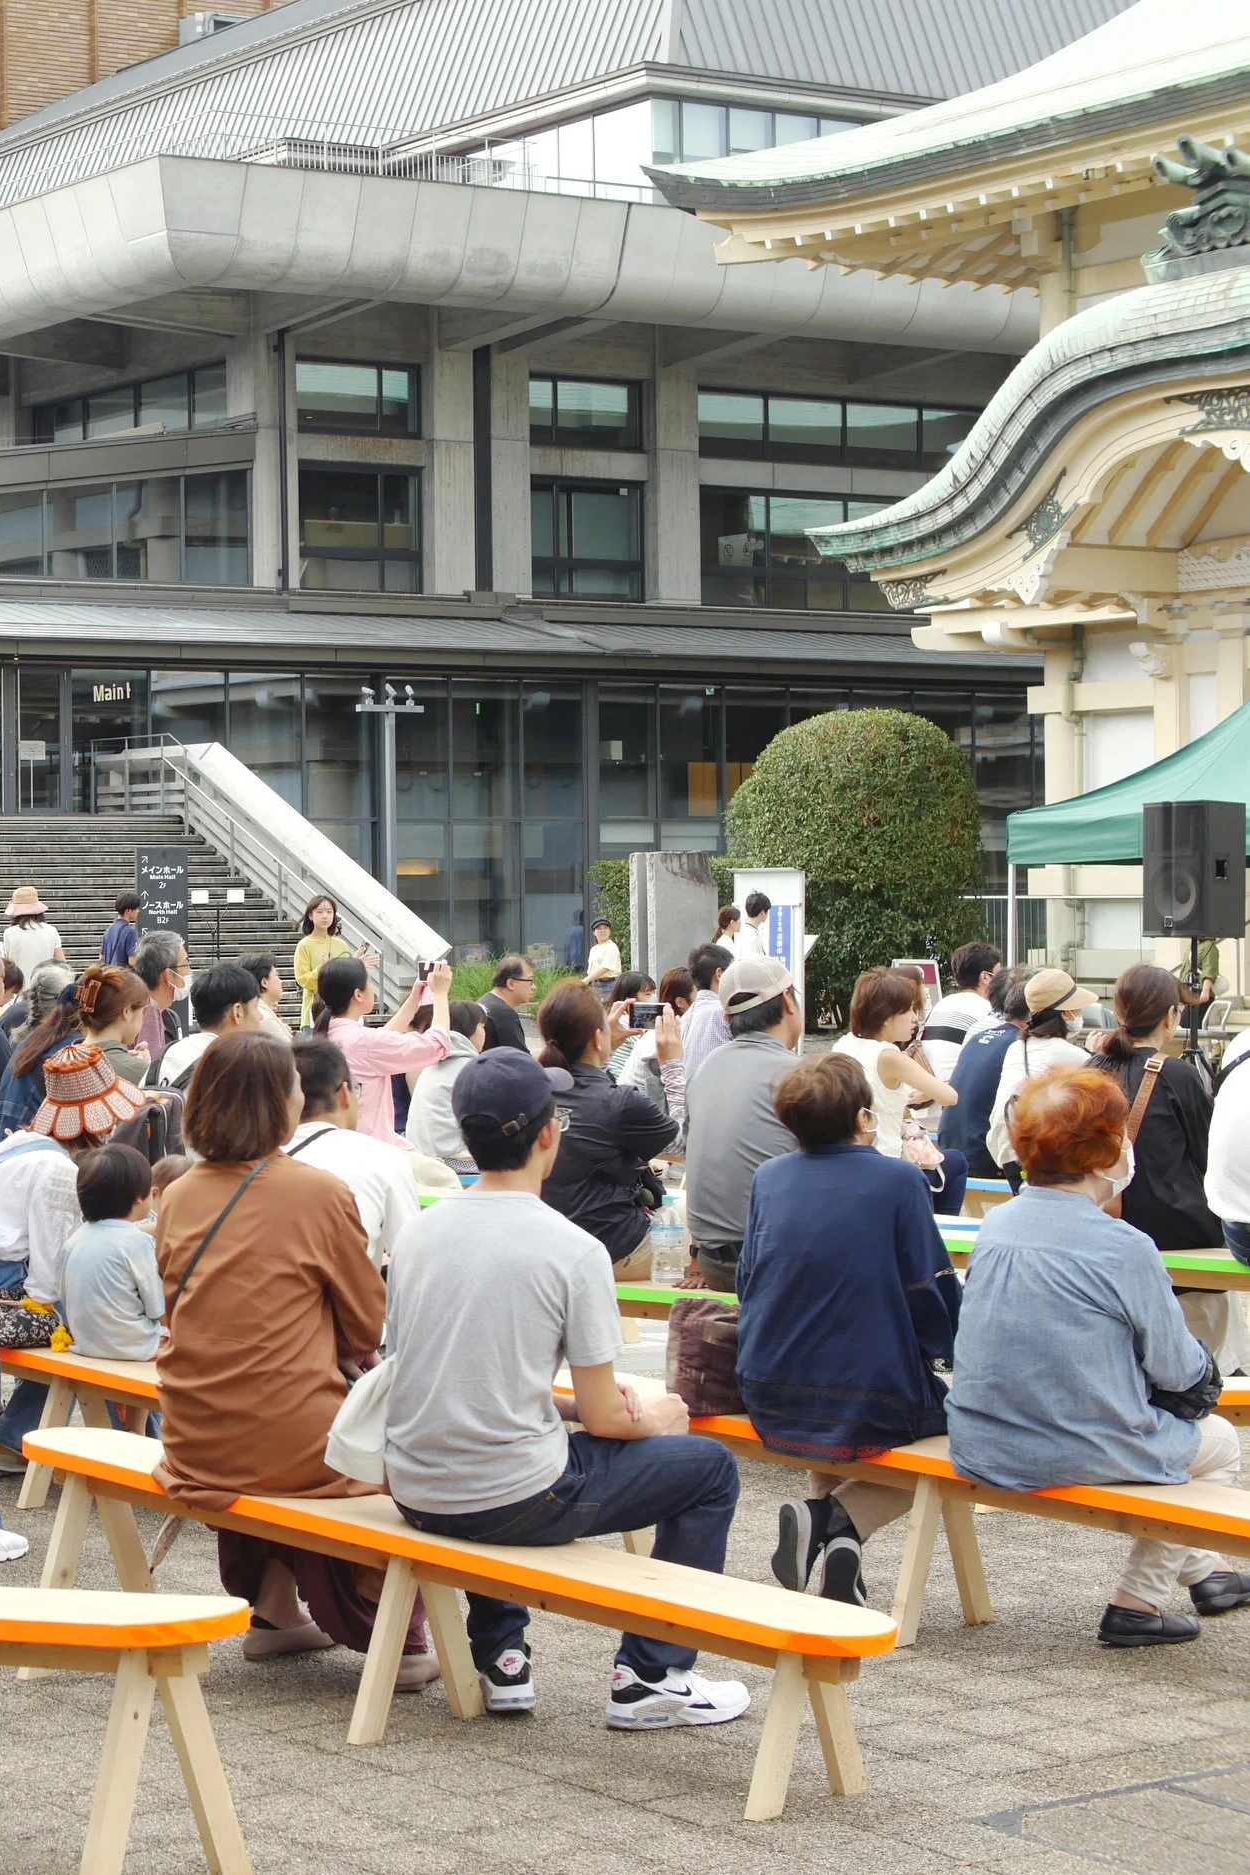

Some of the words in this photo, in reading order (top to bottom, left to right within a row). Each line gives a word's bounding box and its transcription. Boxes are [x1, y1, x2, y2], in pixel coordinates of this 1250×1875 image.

[93, 683, 124, 703] Main
[141, 865, 184, 875] メインホール
[158, 881, 167, 889] 2F
[142, 901, 184, 910] ノースホール
[156, 916, 170, 924] B2F
